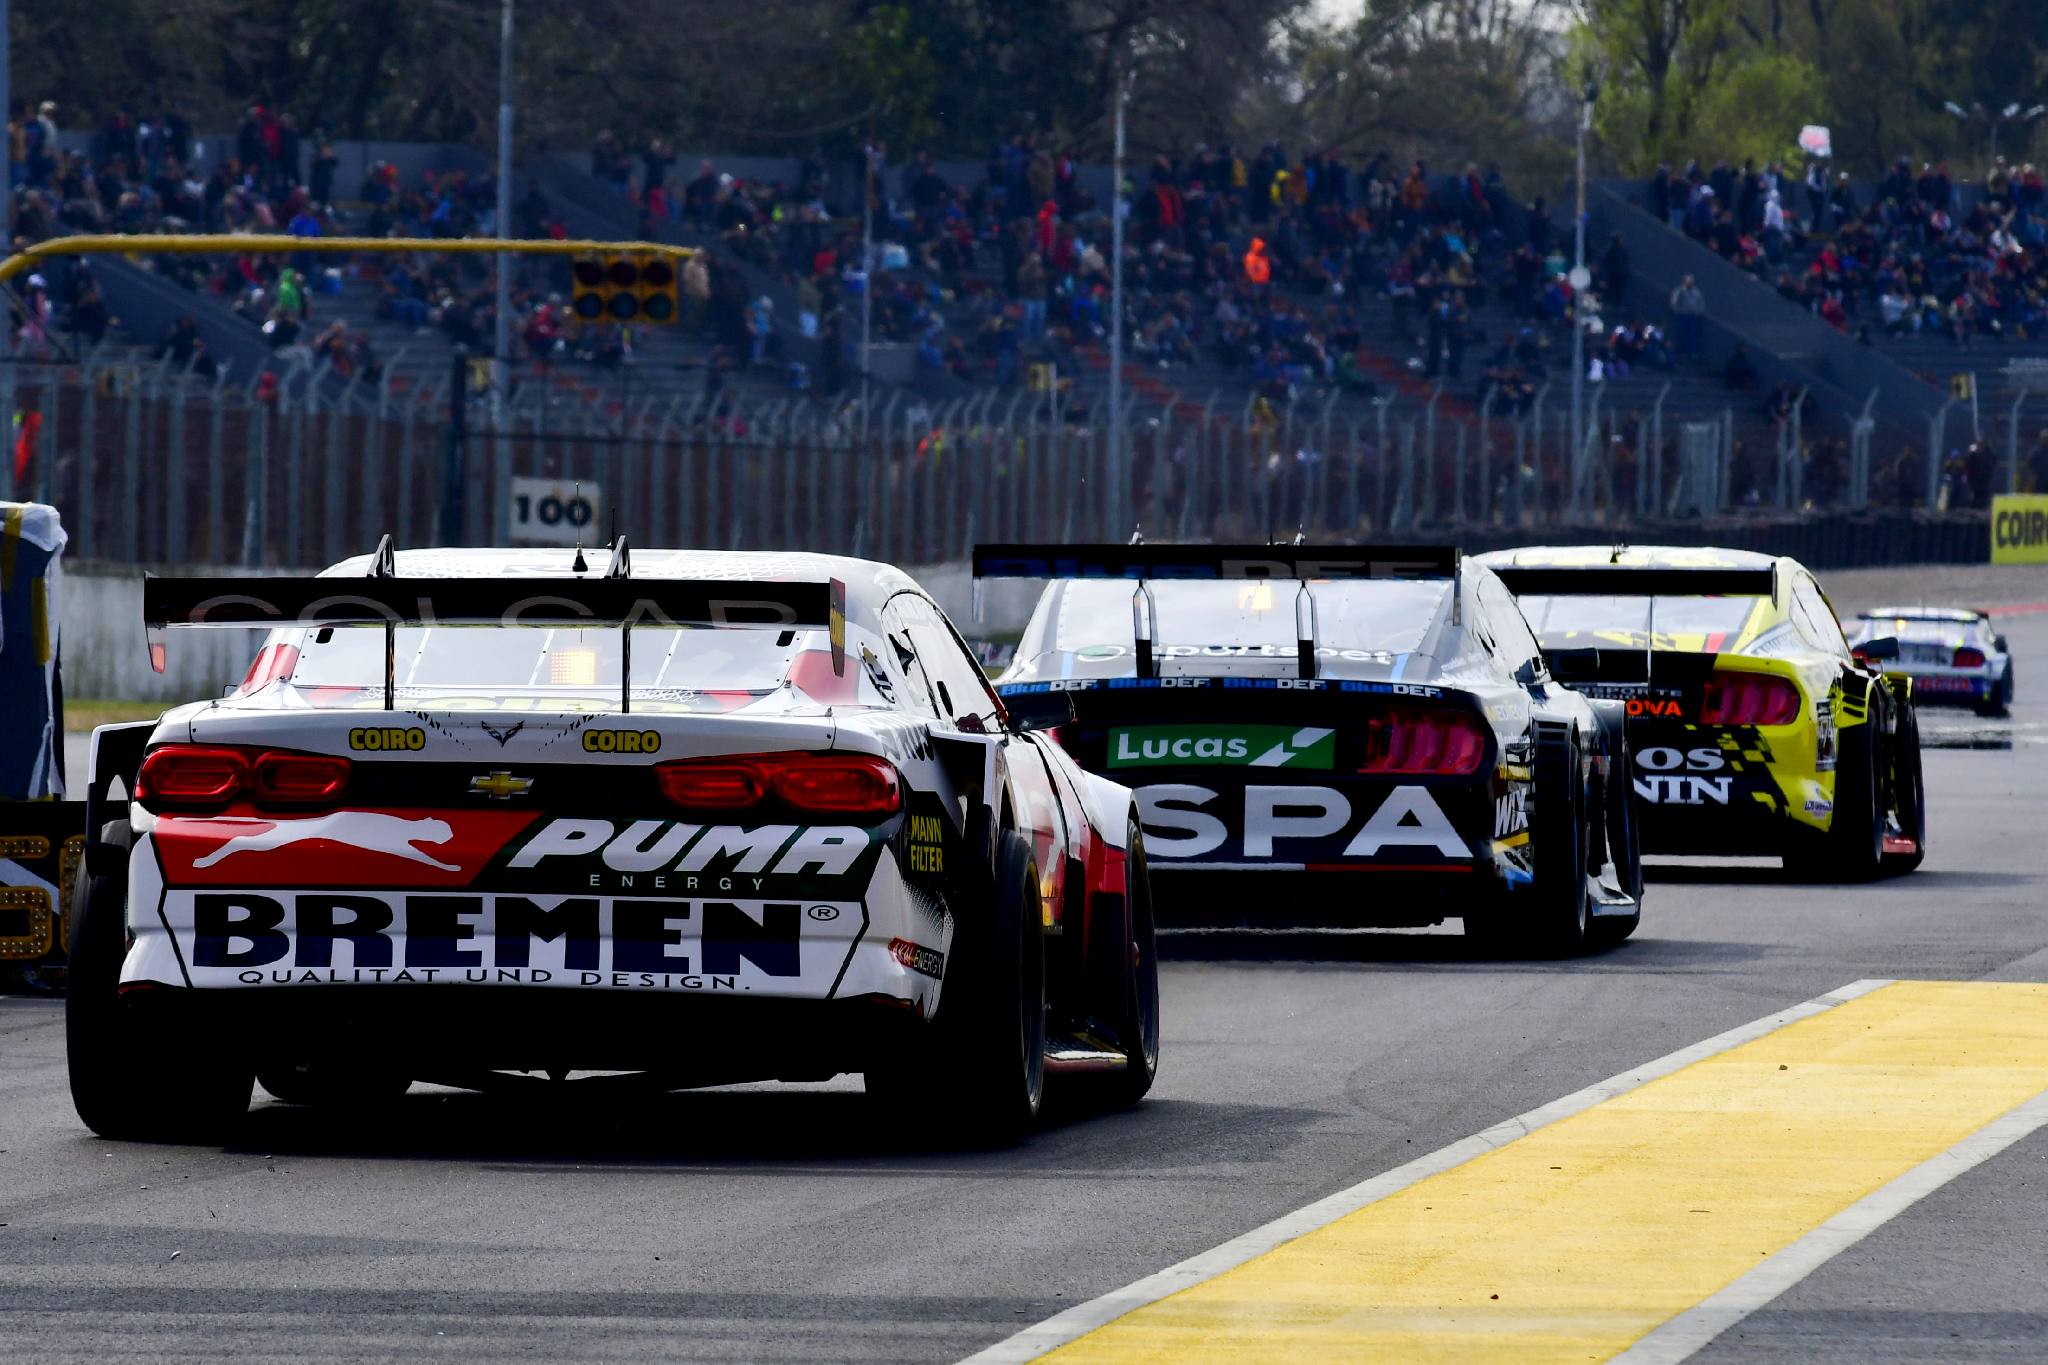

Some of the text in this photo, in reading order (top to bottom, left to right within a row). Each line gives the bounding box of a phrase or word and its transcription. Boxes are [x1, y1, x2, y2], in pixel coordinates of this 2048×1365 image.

[514, 494, 592, 527] 100
[1996, 510, 2048, 548] COIR
[350, 728, 661, 753] COIRO COIRO
[1117, 732, 1248, 760] Lucas
[1494, 788, 1529, 838] WIX
[911, 815, 942, 843] MANN
[506, 818, 870, 875] PUMA
[911, 845, 943, 872] FILTER
[589, 874, 764, 891] ENERGY
[193, 894, 802, 977] BREMEN
[913, 949, 943, 975] ENERGY
[238, 968, 441, 985] QUALITAT
[466, 968, 553, 984] UND
